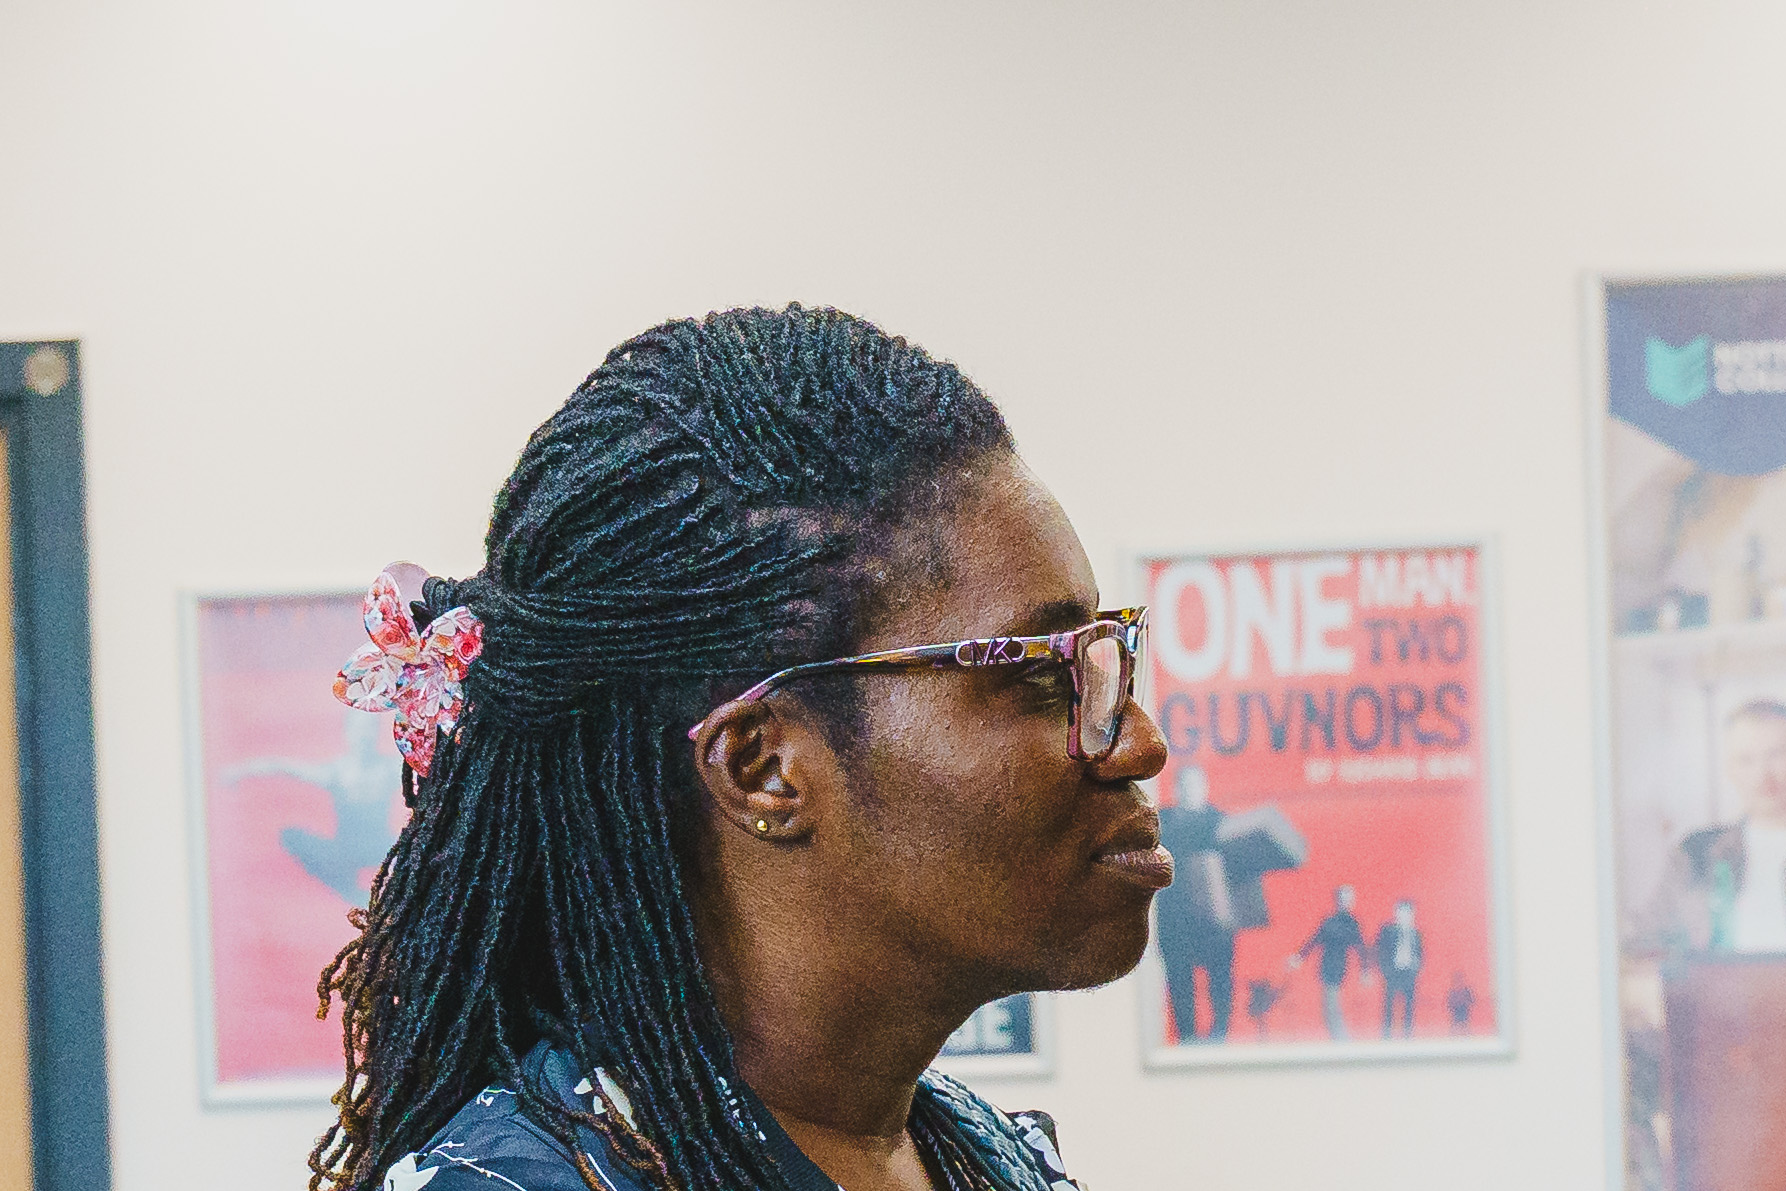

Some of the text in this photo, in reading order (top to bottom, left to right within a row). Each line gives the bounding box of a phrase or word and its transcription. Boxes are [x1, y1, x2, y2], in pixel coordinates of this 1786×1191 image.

[1154, 557, 1356, 682] ONE
[1363, 615, 1469, 666] TWO
[1161, 681, 1472, 758] GUVNORS
